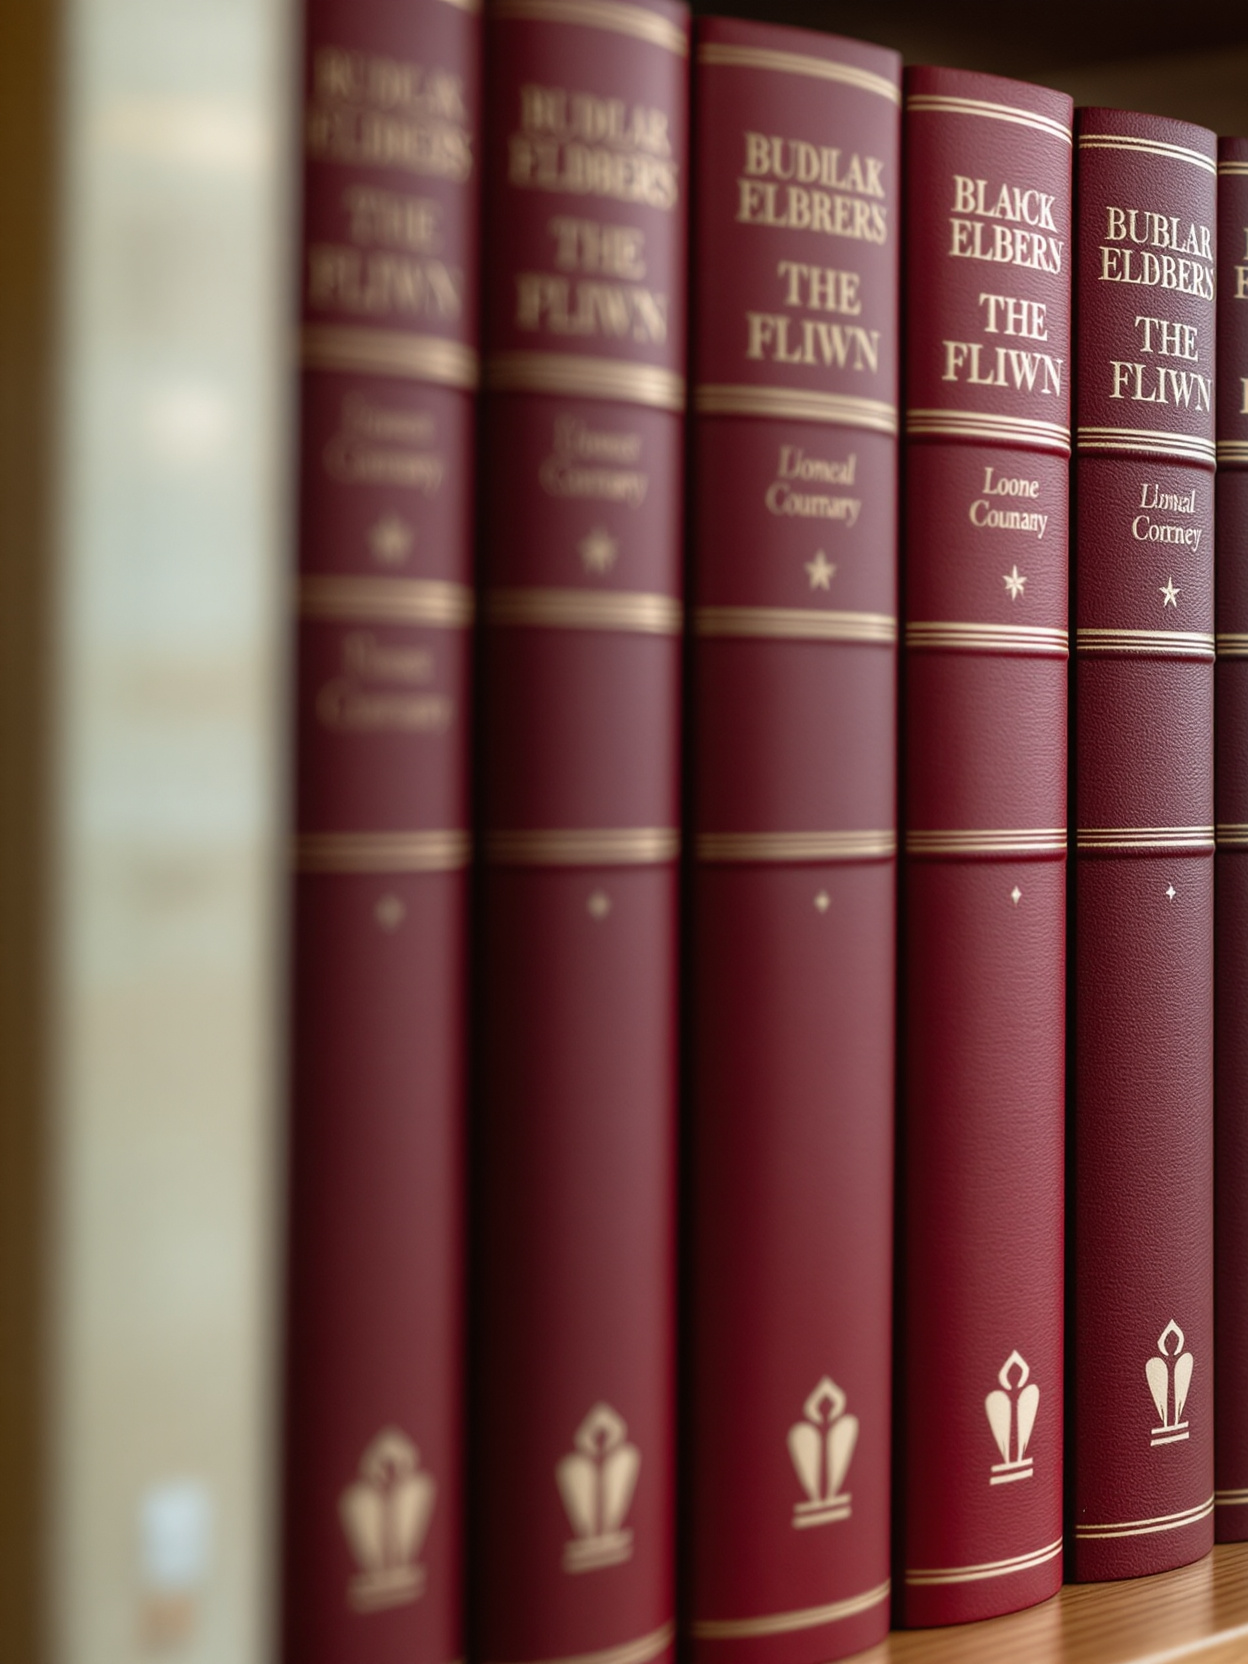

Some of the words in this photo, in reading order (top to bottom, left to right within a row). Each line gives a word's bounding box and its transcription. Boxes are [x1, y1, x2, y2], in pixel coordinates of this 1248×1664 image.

[550, 216, 647, 281] THE
[1104, 206, 1213, 261] BUBLAR
[777, 260, 861, 316] THE
[1098, 246, 1214, 301] ELDBERS
[746, 311, 881, 374] FLIWN
[979, 292, 1047, 342] THE
[1134, 316, 1199, 362] THE
[942, 340, 1064, 397] FLIWN
[1109, 360, 1211, 412] FLIWN
[982, 467, 1039, 498] Loone
